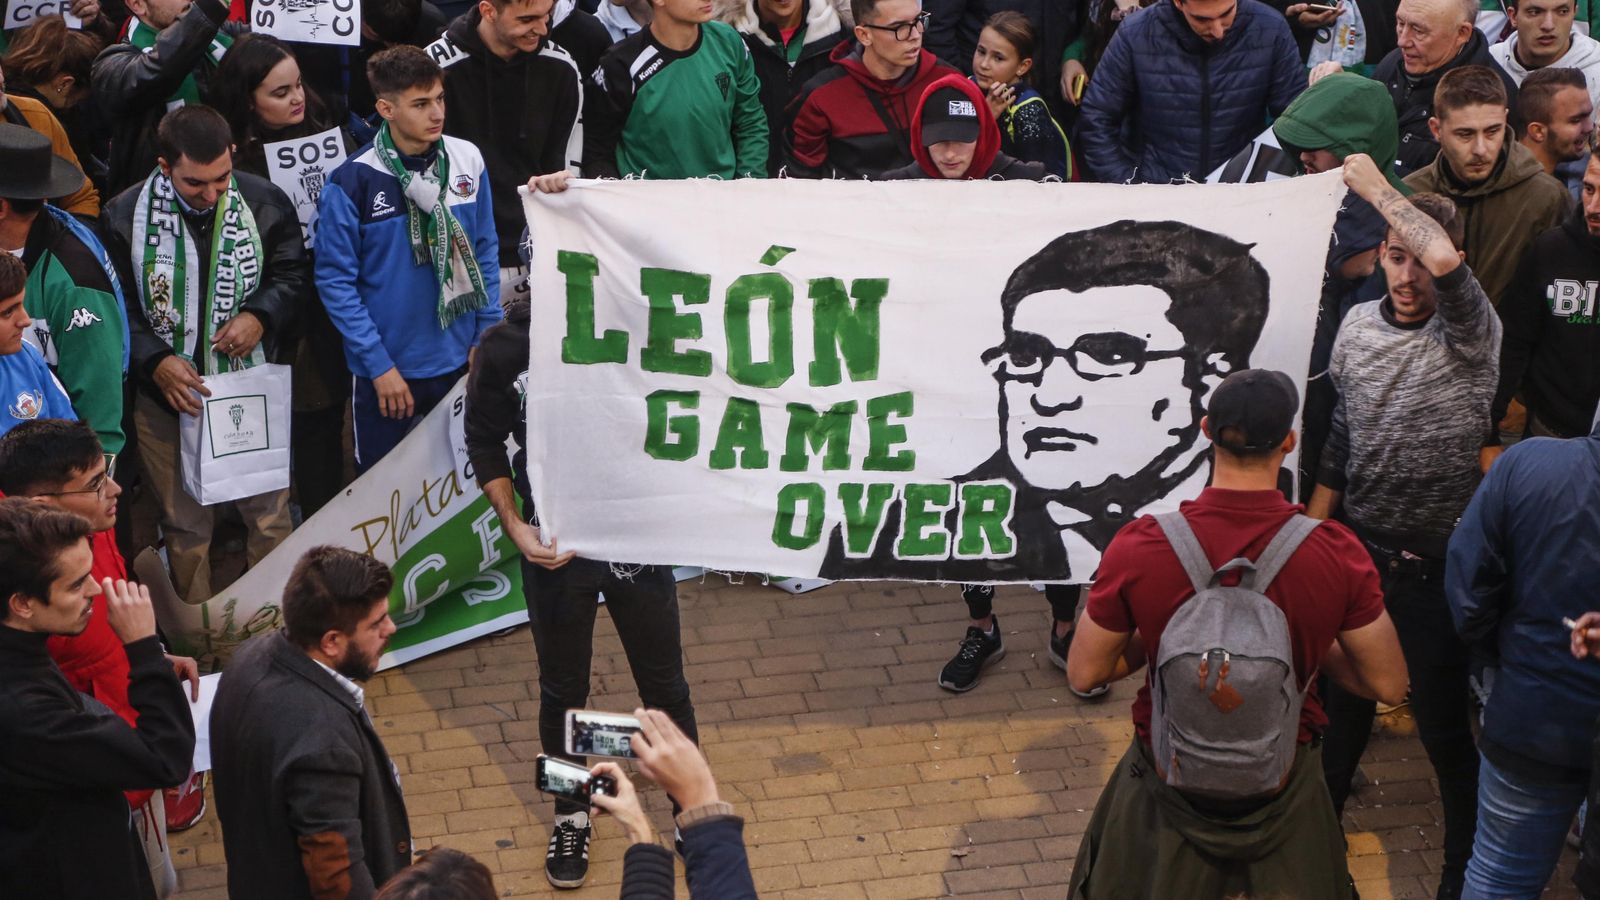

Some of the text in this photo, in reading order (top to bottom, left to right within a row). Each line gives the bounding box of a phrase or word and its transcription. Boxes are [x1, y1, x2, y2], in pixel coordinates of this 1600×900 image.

[638, 58, 664, 81] Kappa
[277, 136, 339, 169] SOS
[557, 244, 890, 389] LEÓN
[644, 390, 915, 473] GAME
[771, 482, 1013, 556] OVER
